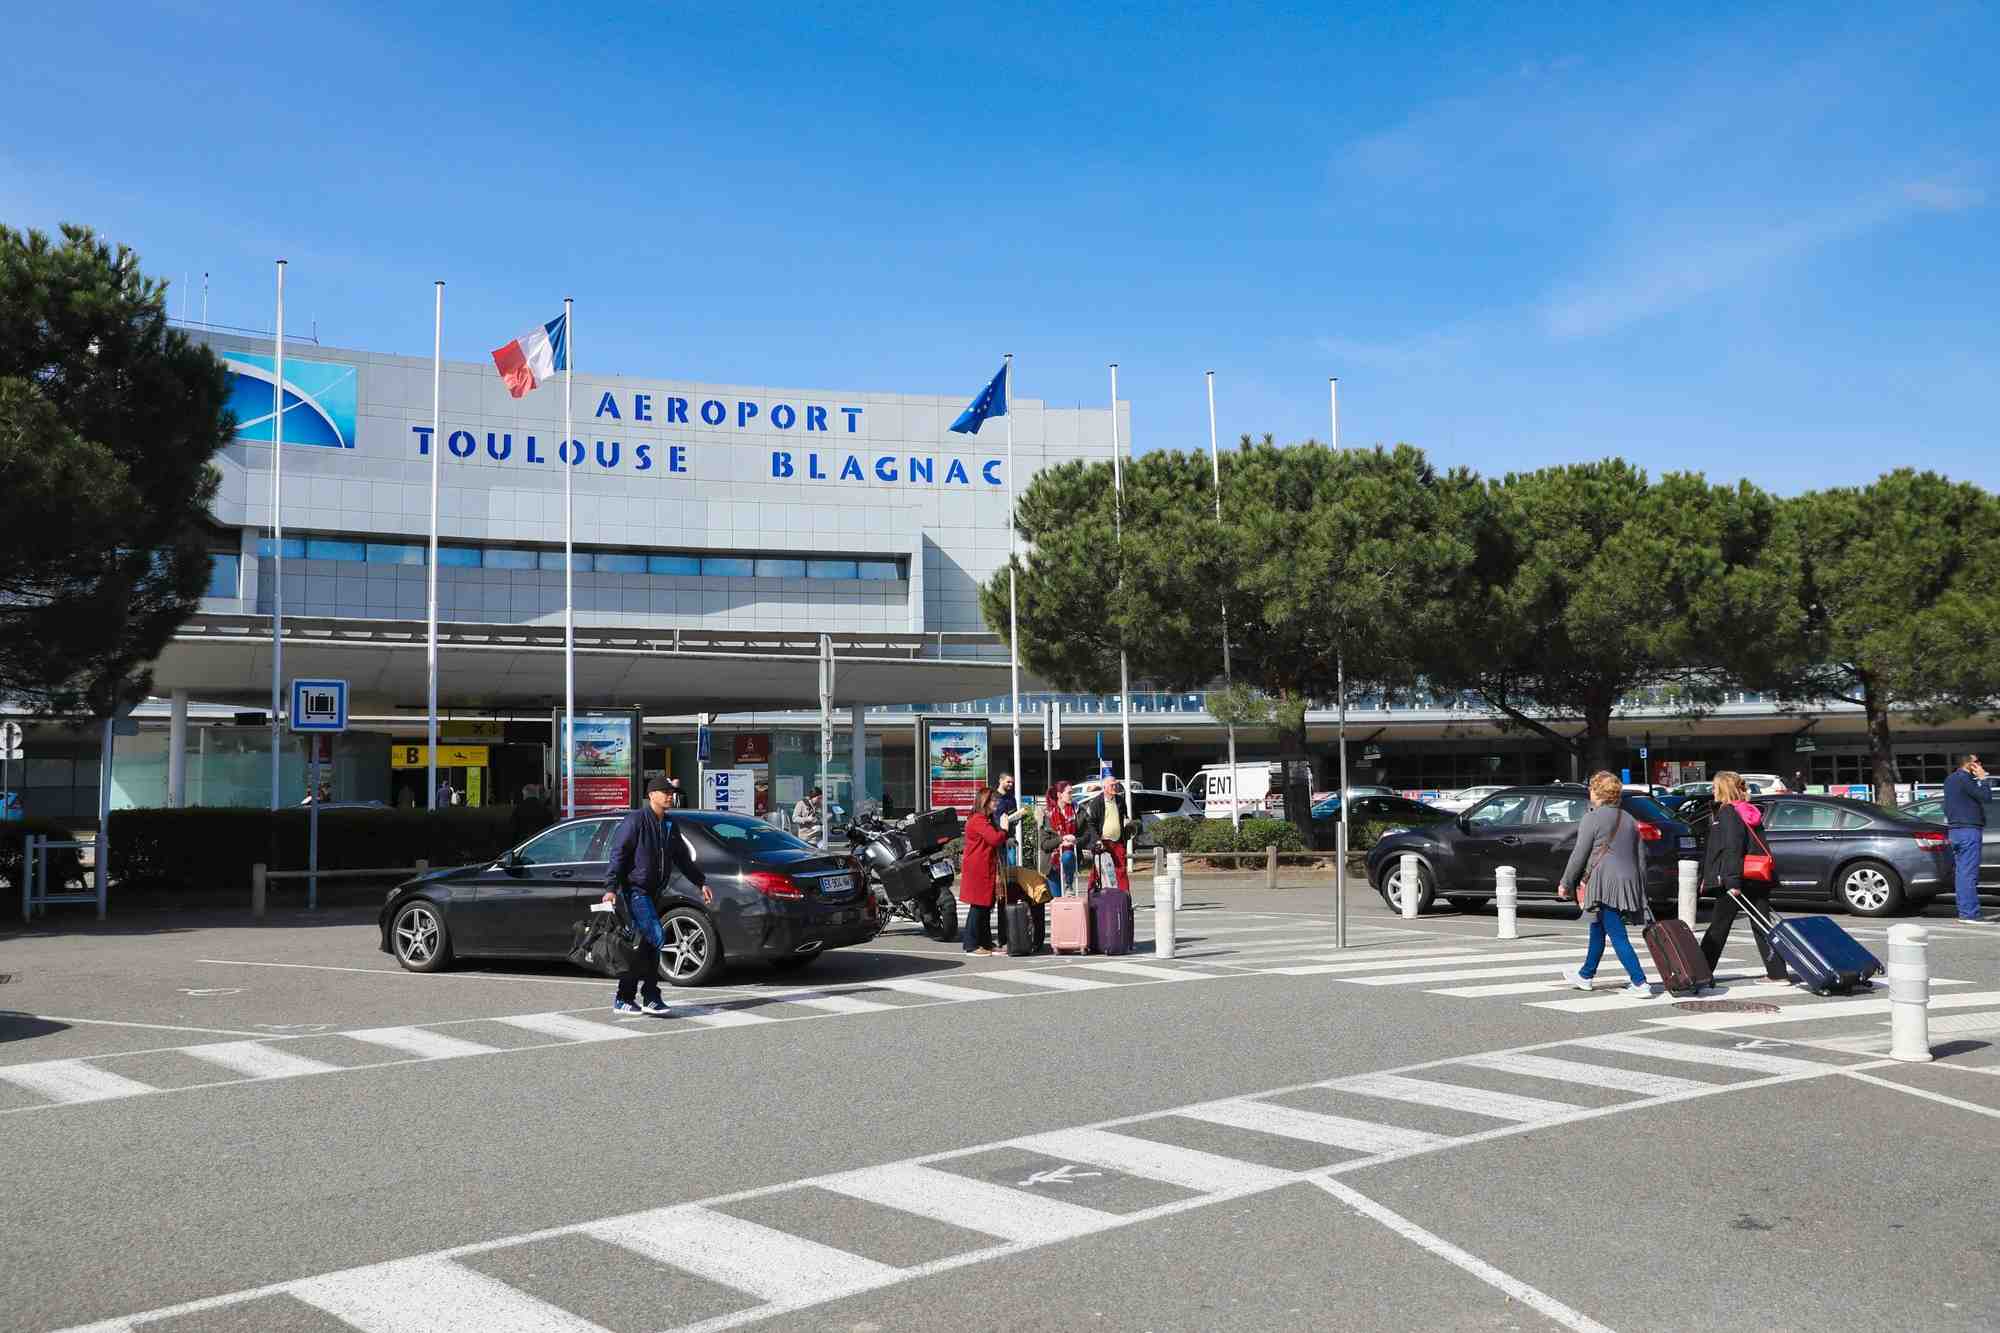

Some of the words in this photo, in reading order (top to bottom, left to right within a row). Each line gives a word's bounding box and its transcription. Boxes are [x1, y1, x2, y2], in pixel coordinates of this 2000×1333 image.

[595, 391, 864, 433] AEROPORT
[412, 426, 687, 473] TOULOUSE
[771, 451, 1003, 485] BLAGNAC
[406, 747, 419, 764] B
